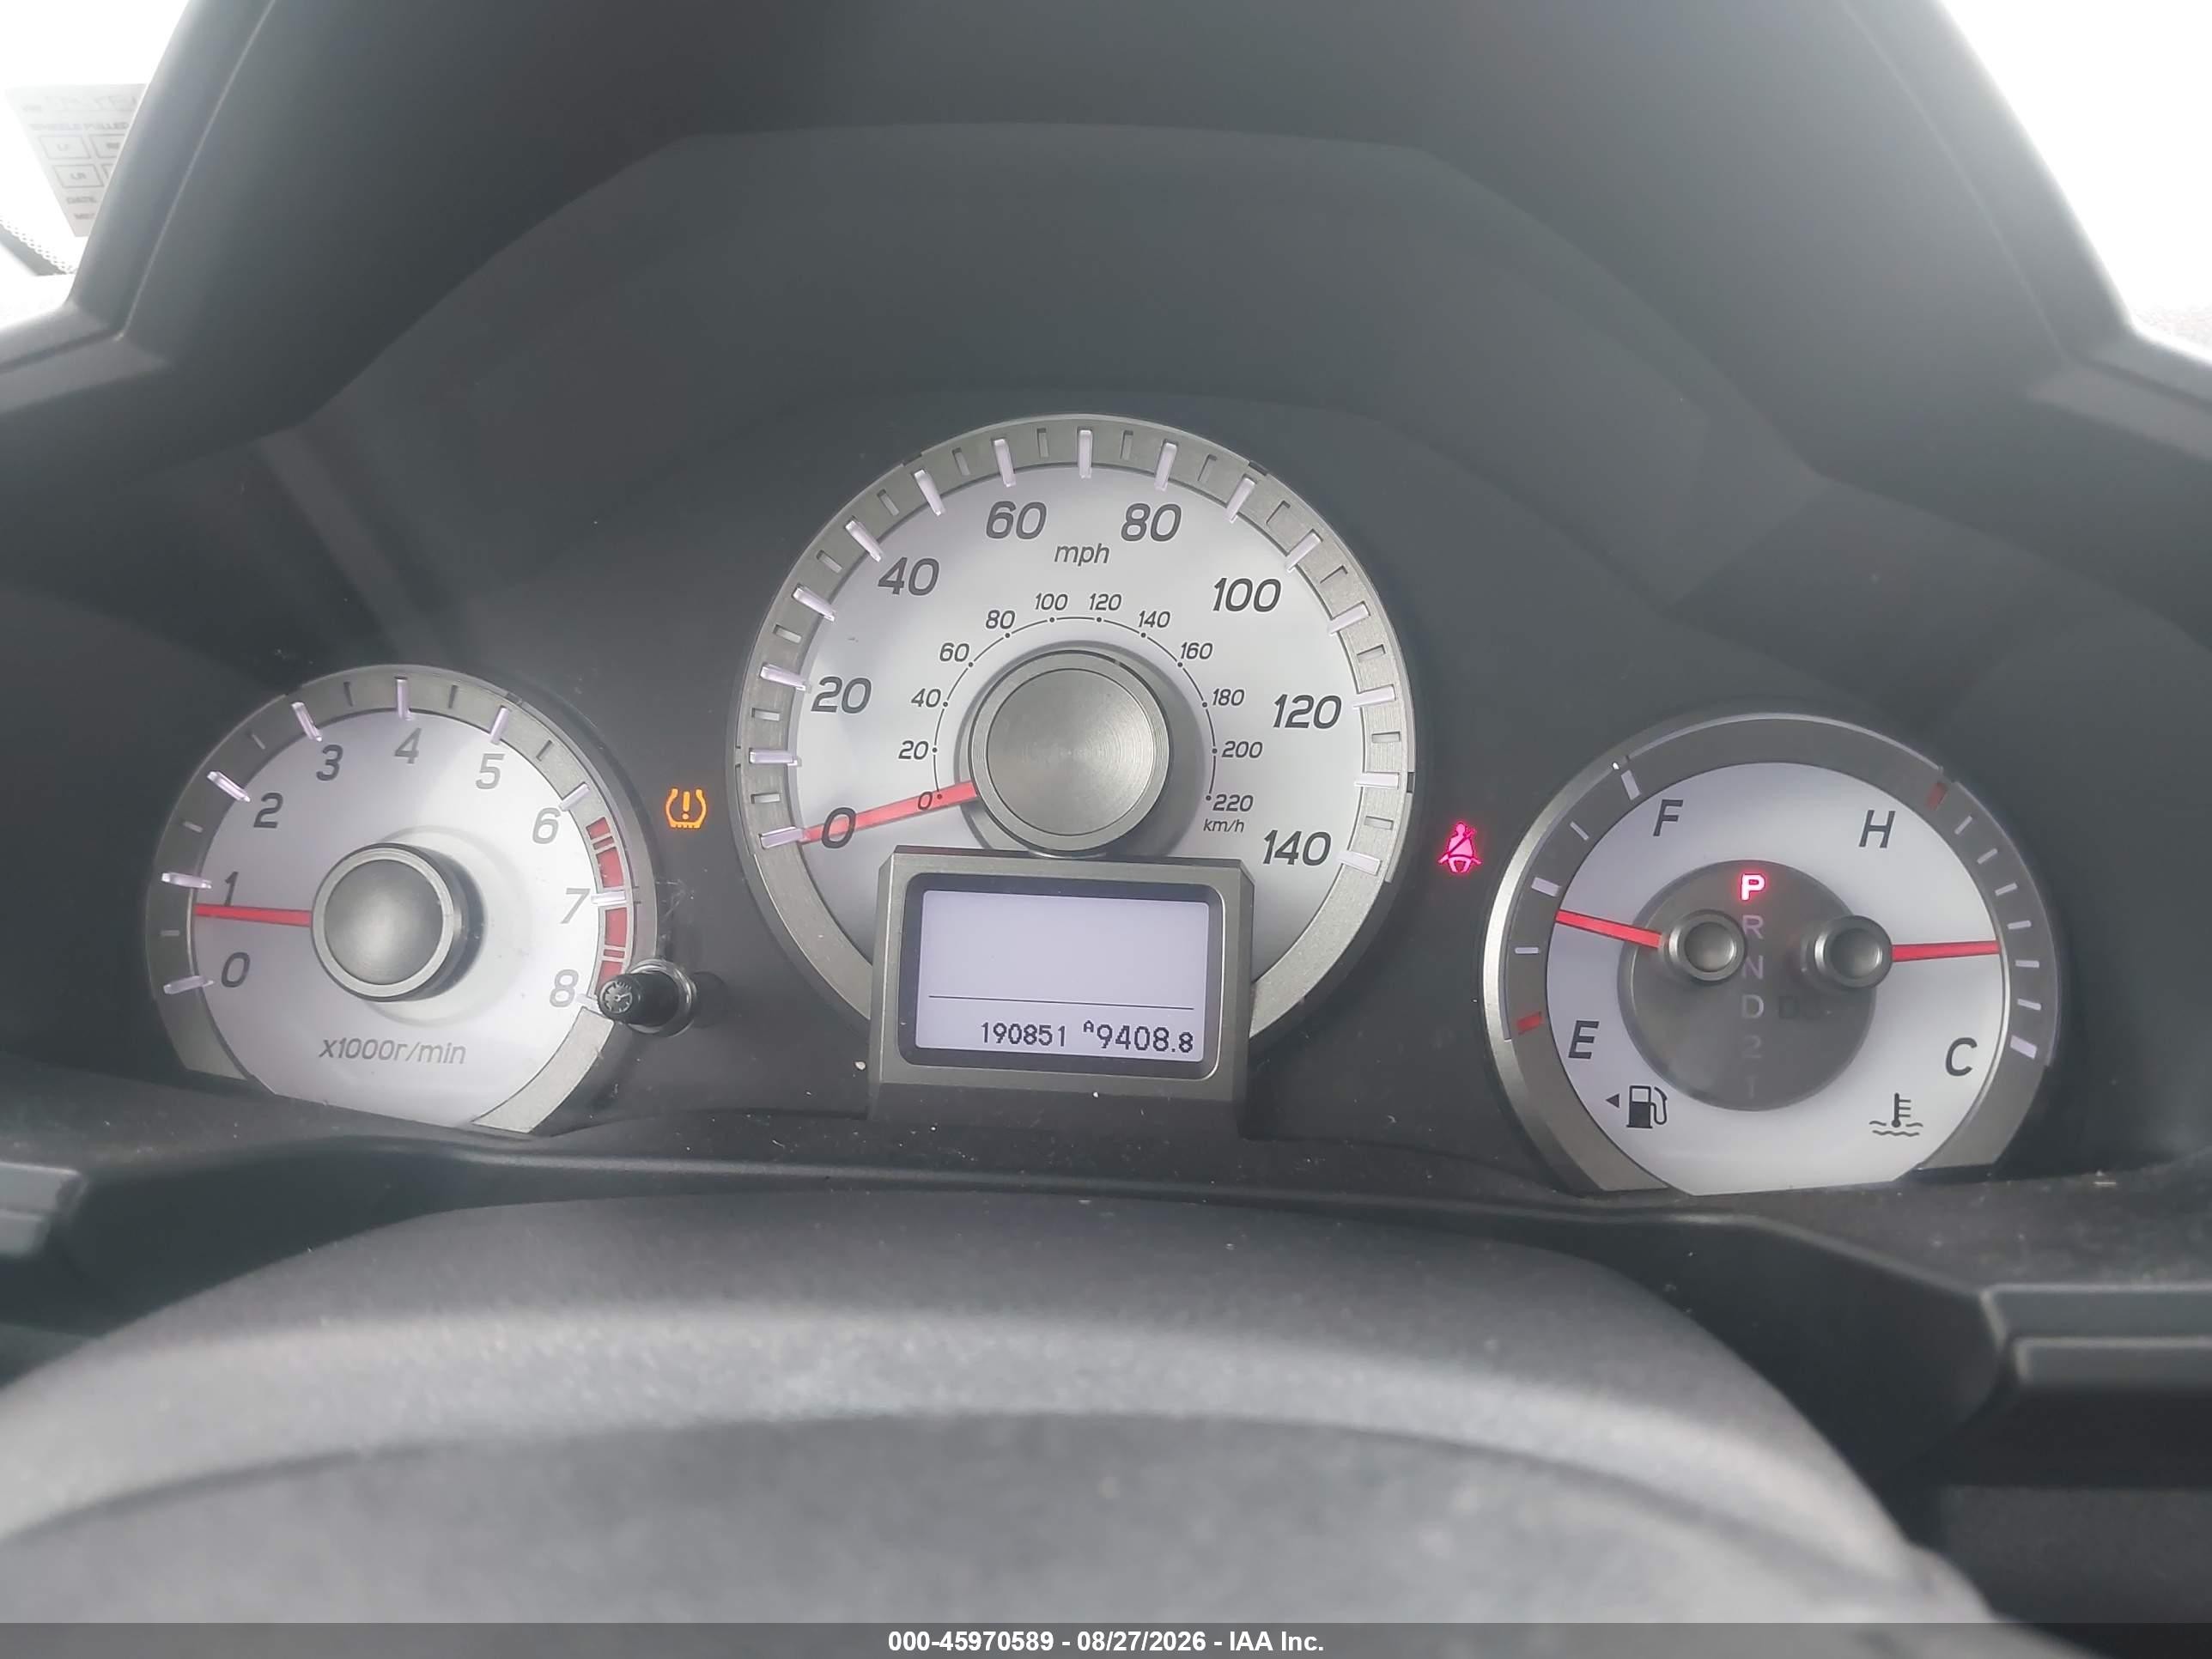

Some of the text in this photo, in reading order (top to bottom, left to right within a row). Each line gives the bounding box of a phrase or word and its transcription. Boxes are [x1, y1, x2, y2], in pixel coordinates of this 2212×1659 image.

[986, 500, 1047, 540] 60
[1121, 502, 1182, 542] 80
[1054, 543, 1110, 567] mph
[877, 556, 939, 596] 40
[1035, 592, 1068, 611] 100
[1089, 592, 1122, 611] 120
[1212, 577, 1281, 613] 100
[985, 609, 1016, 631] 80
[1138, 610, 1171, 629] 140
[939, 642, 969, 662] 60
[1180, 641, 1213, 660] 160
[810, 676, 872, 714] 20
[910, 688, 942, 708] 40
[1212, 688, 1245, 707] 180
[1273, 693, 1342, 730] 120
[315, 744, 343, 781] 3
[394, 727, 422, 764] 4
[897, 739, 929, 760] 20
[1221, 740, 1263, 759] 200
[475, 752, 506, 790] 5
[252, 792, 283, 829] 2
[916, 791, 934, 811] 0
[1212, 792, 1254, 812] 220
[1653, 799, 1684, 837] F
[532, 806, 562, 845] 6
[820, 806, 857, 849] 0
[1203, 817, 1245, 833] km/h
[1858, 809, 1896, 848] H
[1262, 830, 1332, 866] 140
[223, 871, 240, 907] 1
[1737, 872, 1765, 901] P
[560, 888, 591, 925] 7
[1741, 914, 1764, 939] R
[221, 951, 251, 988] 0
[1741, 956, 1765, 980] N
[549, 969, 580, 1008] 8
[1743, 994, 1765, 1018] D
[319, 1036, 466, 1066] x1000r/min
[981, 1022, 1066, 1047] 190851
[1097, 1024, 1194, 1054] 9408.8
[1567, 1019, 1600, 1060] E
[1945, 1036, 1978, 1077] C
